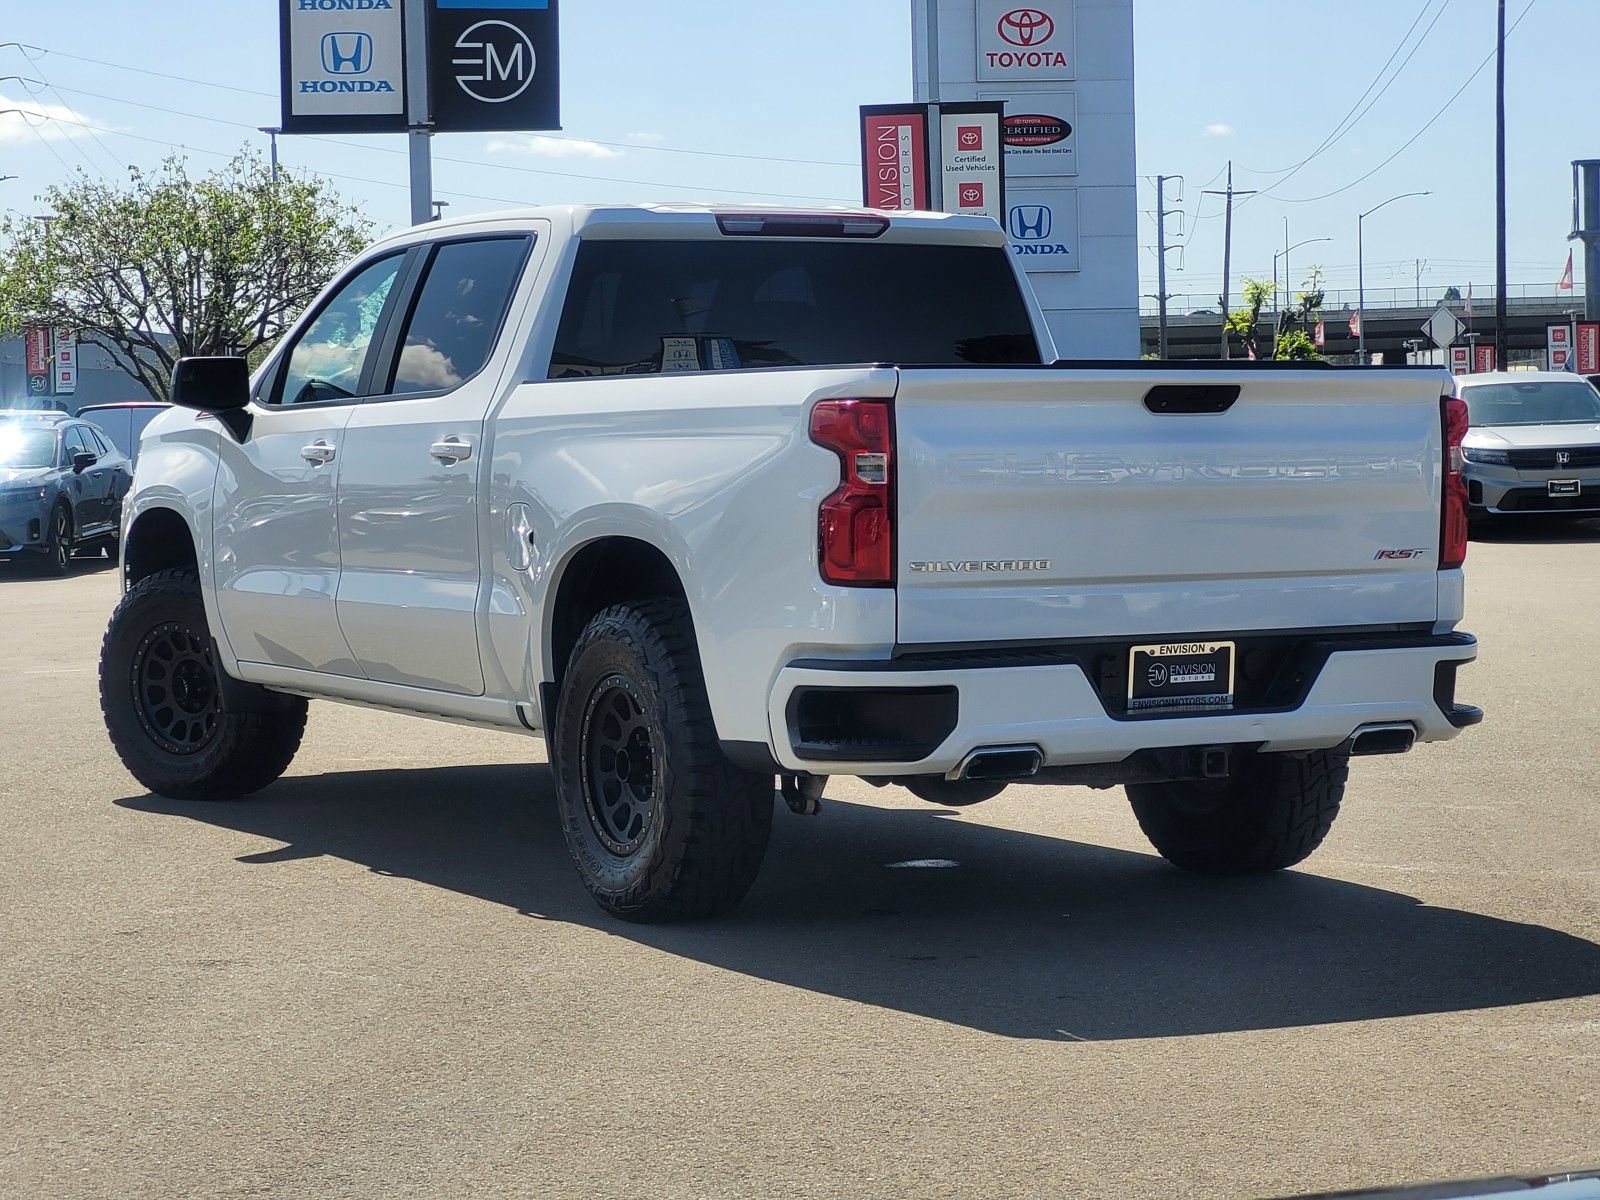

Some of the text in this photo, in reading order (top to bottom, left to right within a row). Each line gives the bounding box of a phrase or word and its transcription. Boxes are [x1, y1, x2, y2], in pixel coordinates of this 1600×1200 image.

[298, 0, 393, 10] HONDA
[986, 52, 1067, 67] TOYOTA
[299, 80, 395, 93] HONDA
[1003, 126, 1061, 135] ERTIFIED
[954, 155, 986, 163] Certified
[877, 126, 899, 210] VISION
[901, 135, 911, 206] OTORS
[1012, 244, 1069, 255] ONDA
[1581, 328, 1589, 369] ENVISION
[909, 559, 1051, 572] SILVERADO
[1160, 644, 1205, 654] ENVISION
[1170, 663, 1216, 675] ENVISION
[1133, 695, 1228, 709] ENVISIONMOTORS.COM
